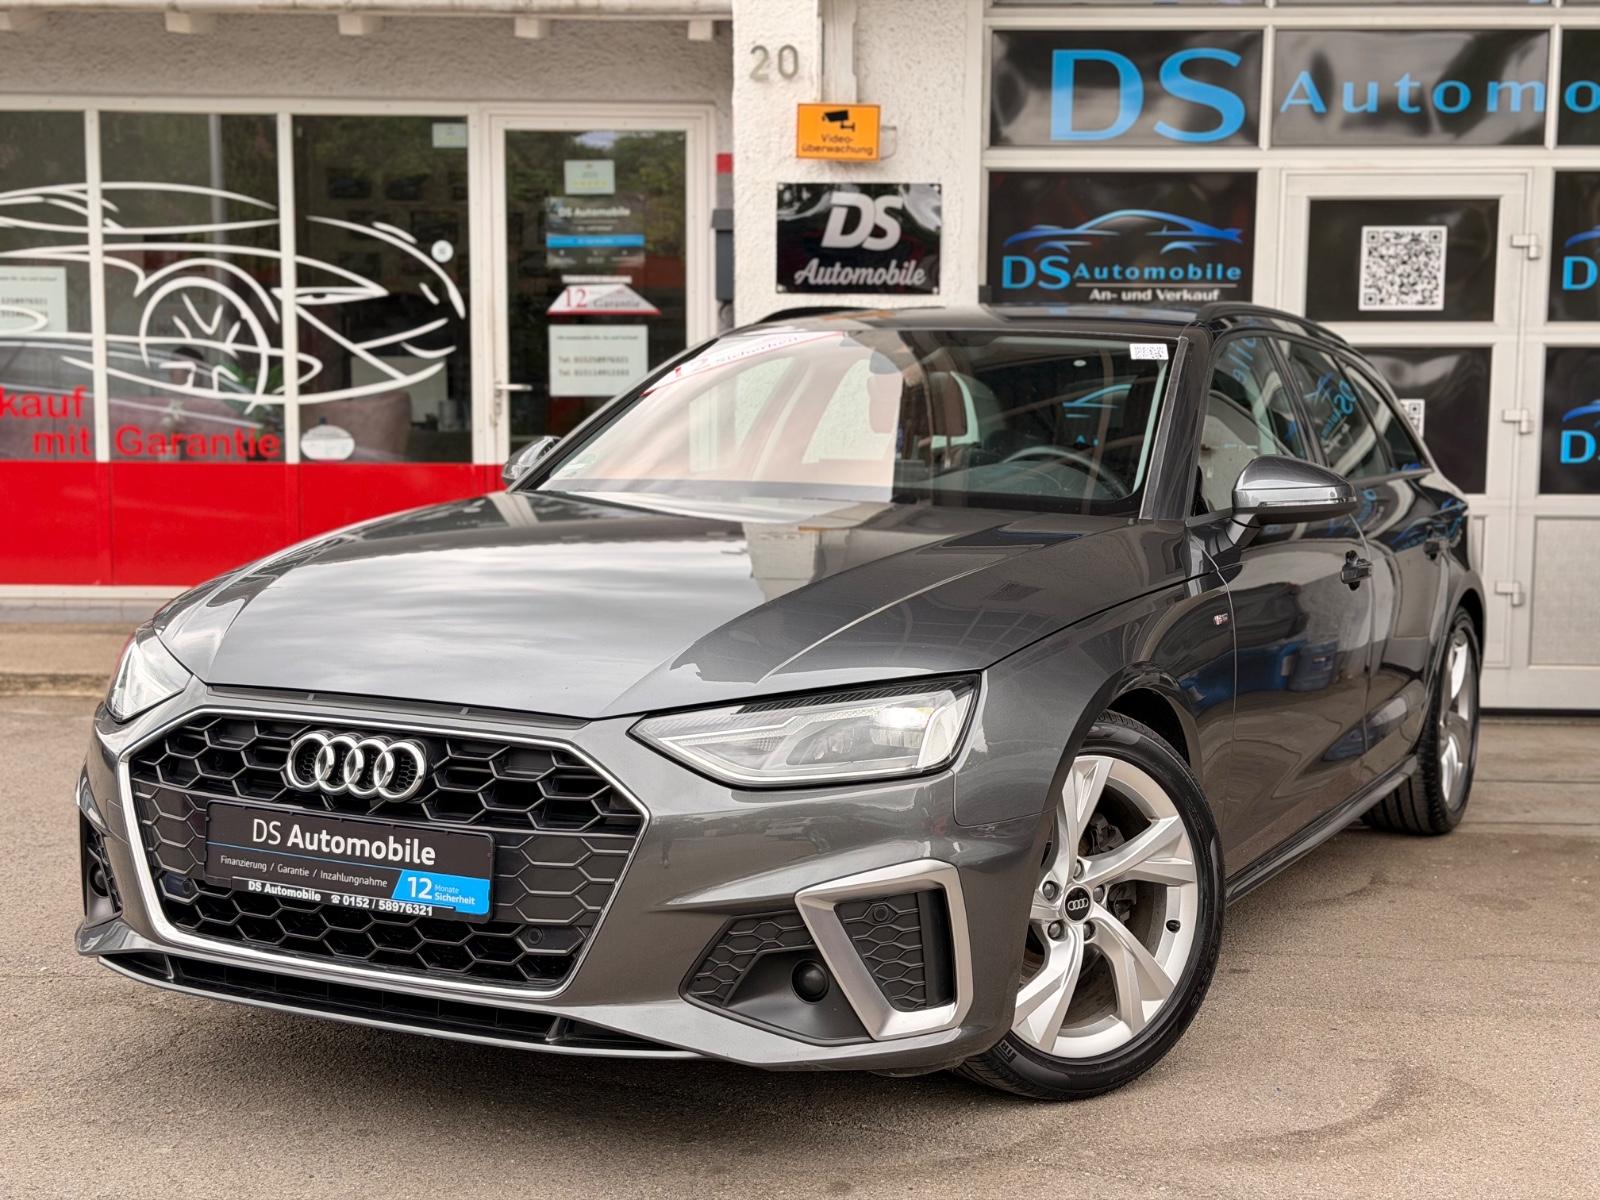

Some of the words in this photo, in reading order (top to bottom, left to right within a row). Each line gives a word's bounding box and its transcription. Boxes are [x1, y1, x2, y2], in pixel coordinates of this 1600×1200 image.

[751, 45, 799, 81] 20
[1049, 47, 1246, 142] DS
[1279, 70, 1600, 114] Automo
[802, 143, 874, 156] überwachung
[821, 134, 854, 144] Video-
[821, 190, 904, 251] DS
[794, 257, 927, 286] Automobile
[1002, 255, 1071, 290] DS
[1073, 263, 1242, 281] Automobile
[566, 288, 587, 308] 12
[1089, 288, 1118, 301] An-
[1121, 288, 1152, 301] und
[1155, 288, 1221, 301] Verkauf
[0, 384, 88, 418] kauf
[32, 424, 93, 456] mit
[114, 425, 281, 457] Garantie
[252, 818, 281, 845] DS
[286, 824, 436, 866] Automobile
[220, 855, 267, 873] Finanzierung
[277, 864, 310, 877] Garantie
[320, 870, 388, 888] Inzahlungnahme
[407, 876, 433, 899] 12
[248, 880, 263, 891] DS
[264, 882, 321, 902] Automobile
[342, 896, 370, 910] 0152
[378, 900, 433, 917] 58976321
[434, 883, 460, 895] Monate
[434, 892, 476, 906] Sicherheit
